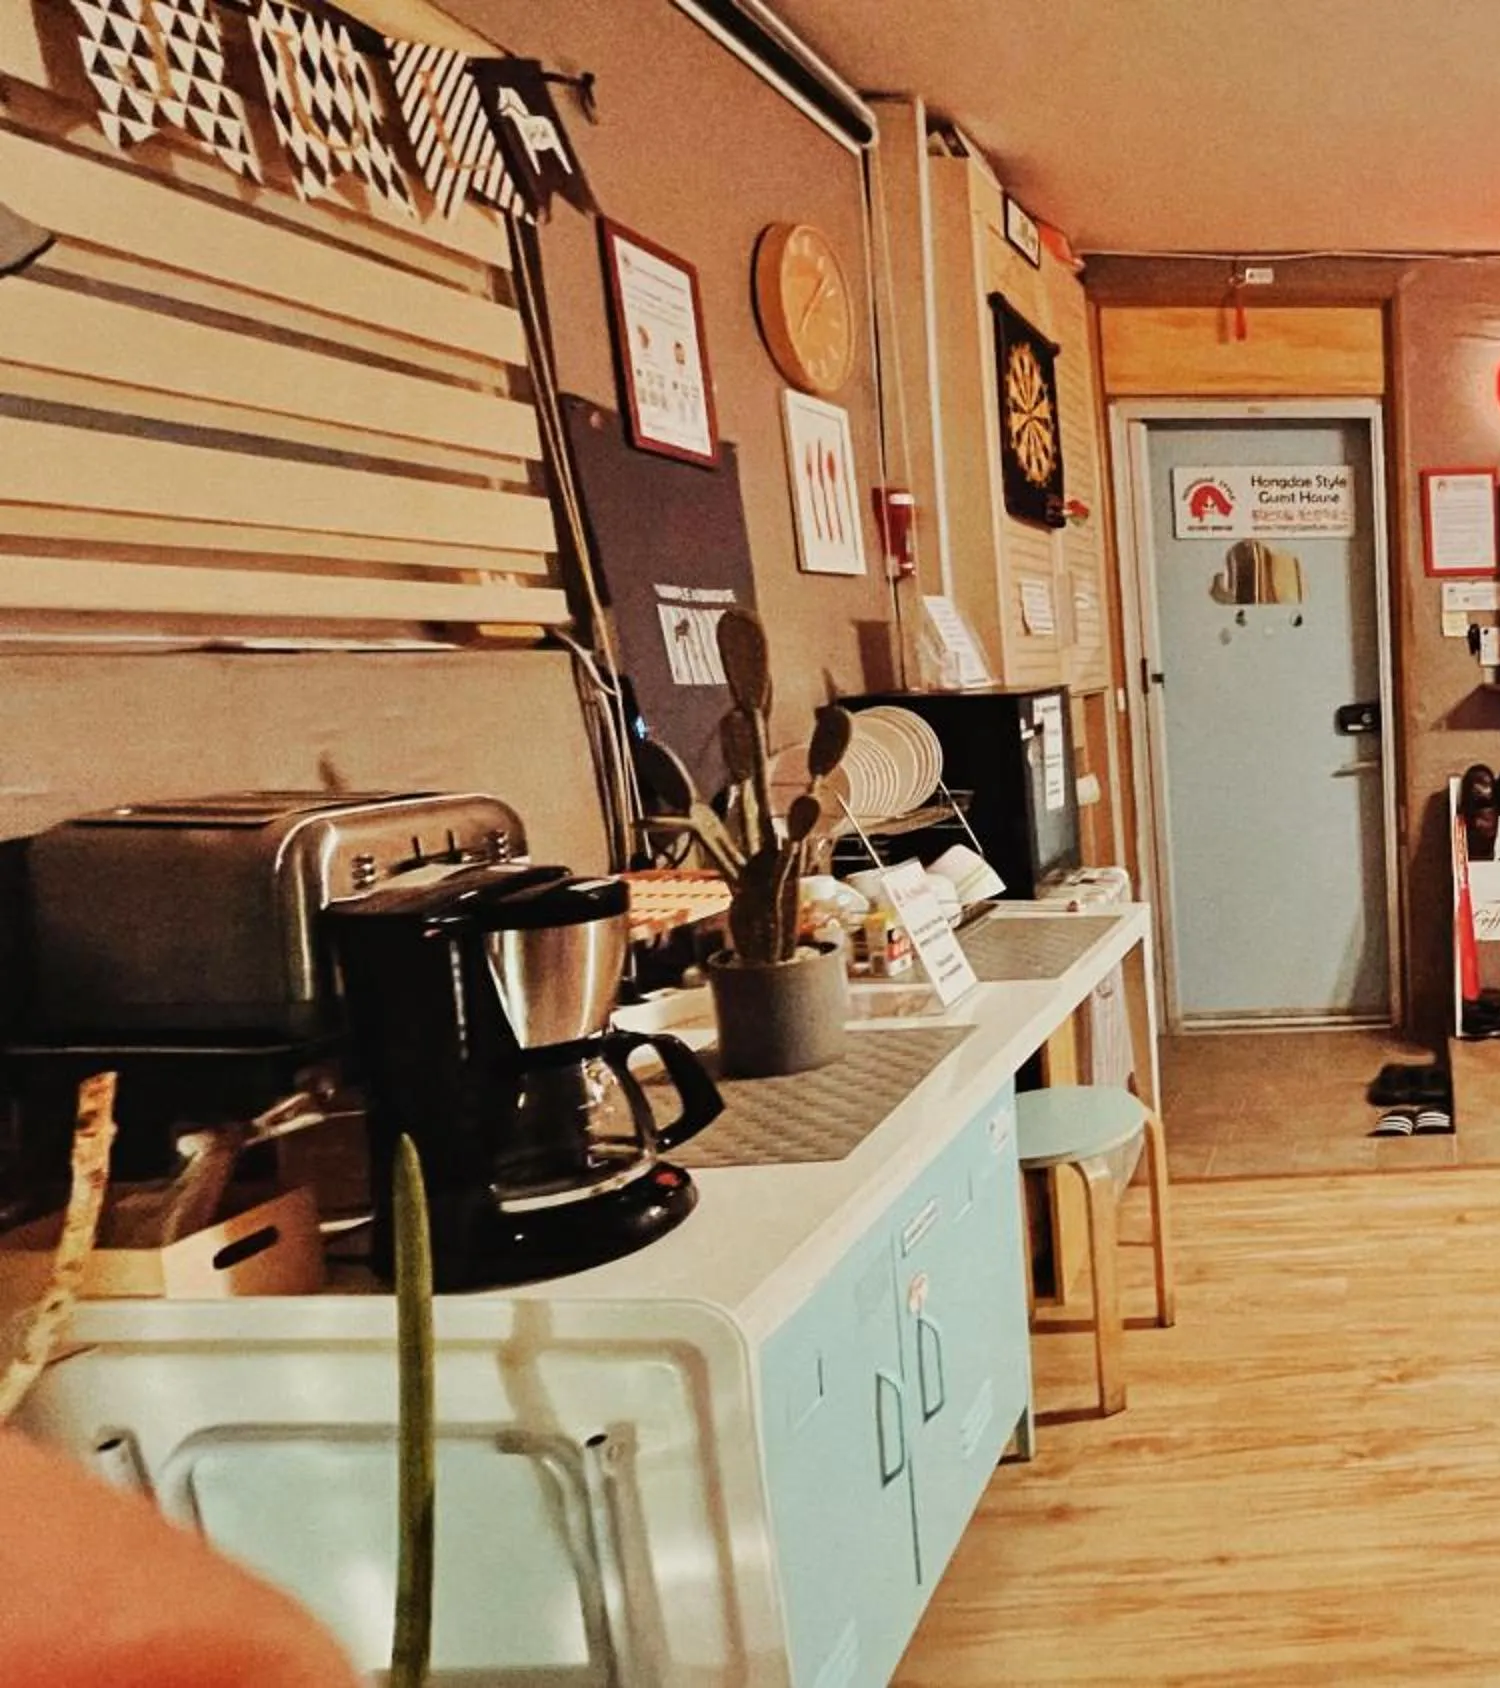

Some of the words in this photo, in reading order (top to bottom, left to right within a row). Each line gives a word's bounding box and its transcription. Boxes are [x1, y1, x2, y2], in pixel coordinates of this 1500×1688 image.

[1251, 474, 1312, 489] Hongdae
[1315, 474, 1347, 489] Style
[1299, 490, 1340, 504] House
